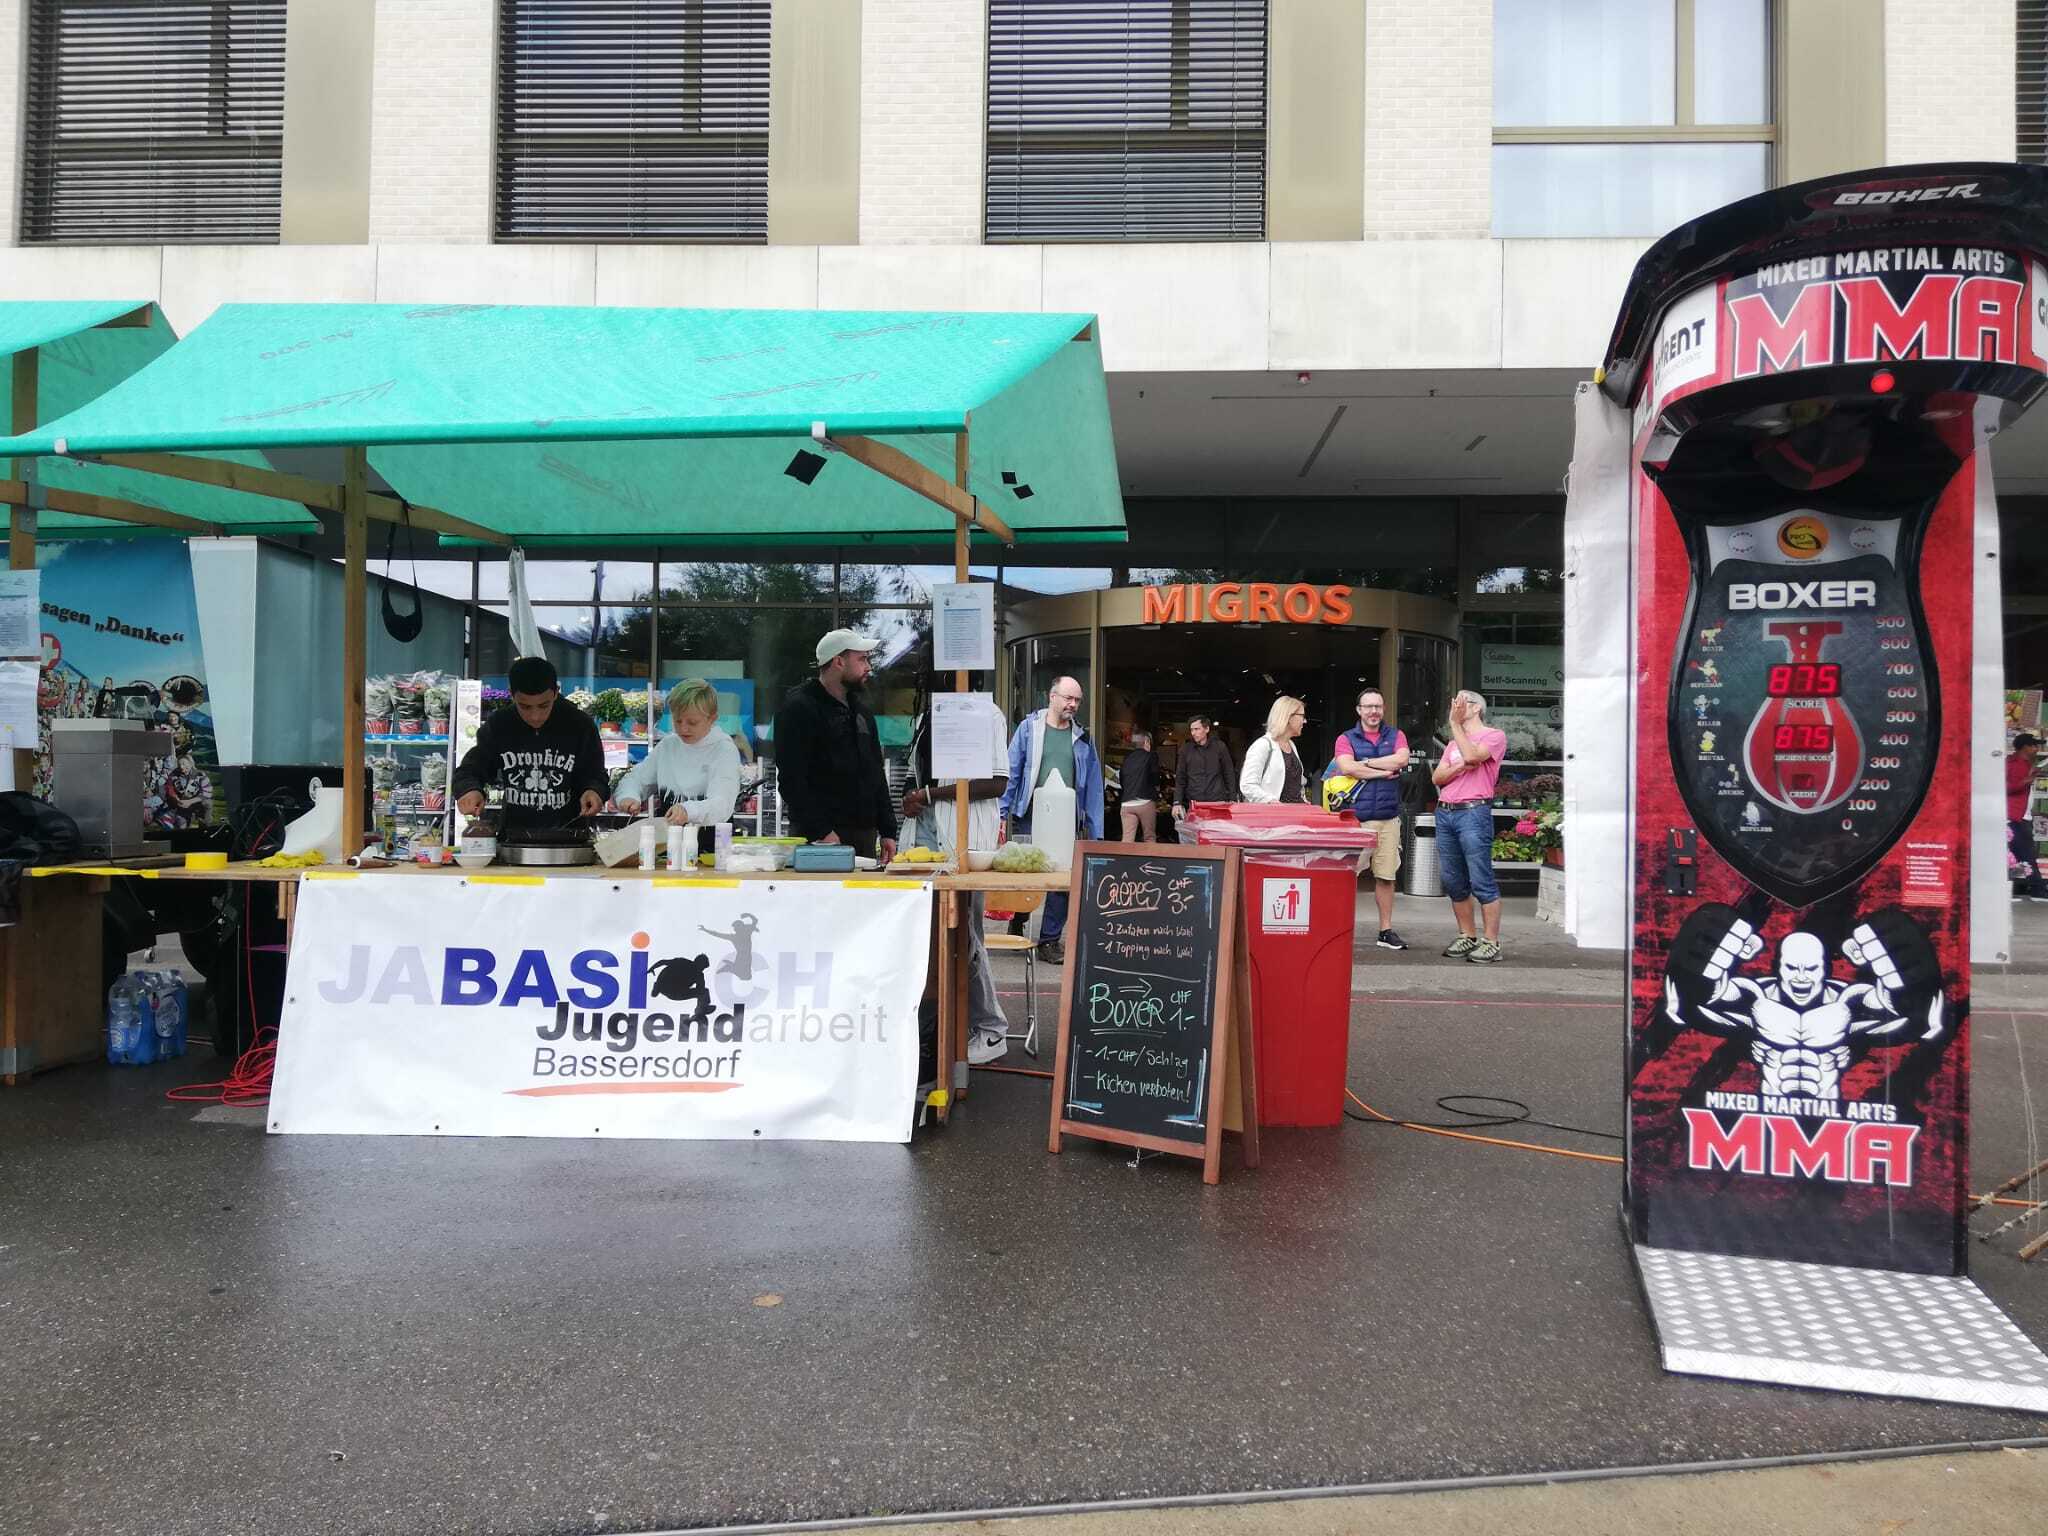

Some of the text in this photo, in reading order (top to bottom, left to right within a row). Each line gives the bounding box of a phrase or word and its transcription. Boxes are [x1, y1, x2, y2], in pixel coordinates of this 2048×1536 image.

[1757, 247, 2006, 289] MIXED MARTIAL ARTS
[1728, 275, 2024, 378] MMA
[1729, 580, 1876, 610] BOXER
[1143, 583, 1353, 624] MIGROS
[41, 600, 91, 625] sagen
[1876, 616, 1905, 629] 900
[1881, 638, 1910, 650] 800
[1886, 663, 1914, 675] 700
[1483, 675, 1548, 687] Self-Scanning
[1769, 665, 1839, 694] 875
[1887, 687, 1917, 699] 600
[1787, 699, 1824, 709] SCORE
[1886, 711, 1916, 723] 500
[1775, 726, 1830, 749] 875
[1879, 734, 1909, 746] 400
[1870, 757, 1900, 768] 300
[1860, 779, 1890, 791] 200
[1847, 799, 1876, 811] 100
[1842, 819, 1852, 830] 0
[1167, 877, 1193, 891] CHF
[1116, 941, 1150, 961] Topping
[1169, 990, 1193, 1004] CHF
[536, 1001, 888, 1053] Jugendarbeit
[533, 1047, 742, 1078] Bassersdorf
[1705, 1092, 1897, 1122] MIXED MARTIAL ARTS
[1682, 1108, 1921, 1187] MMA
